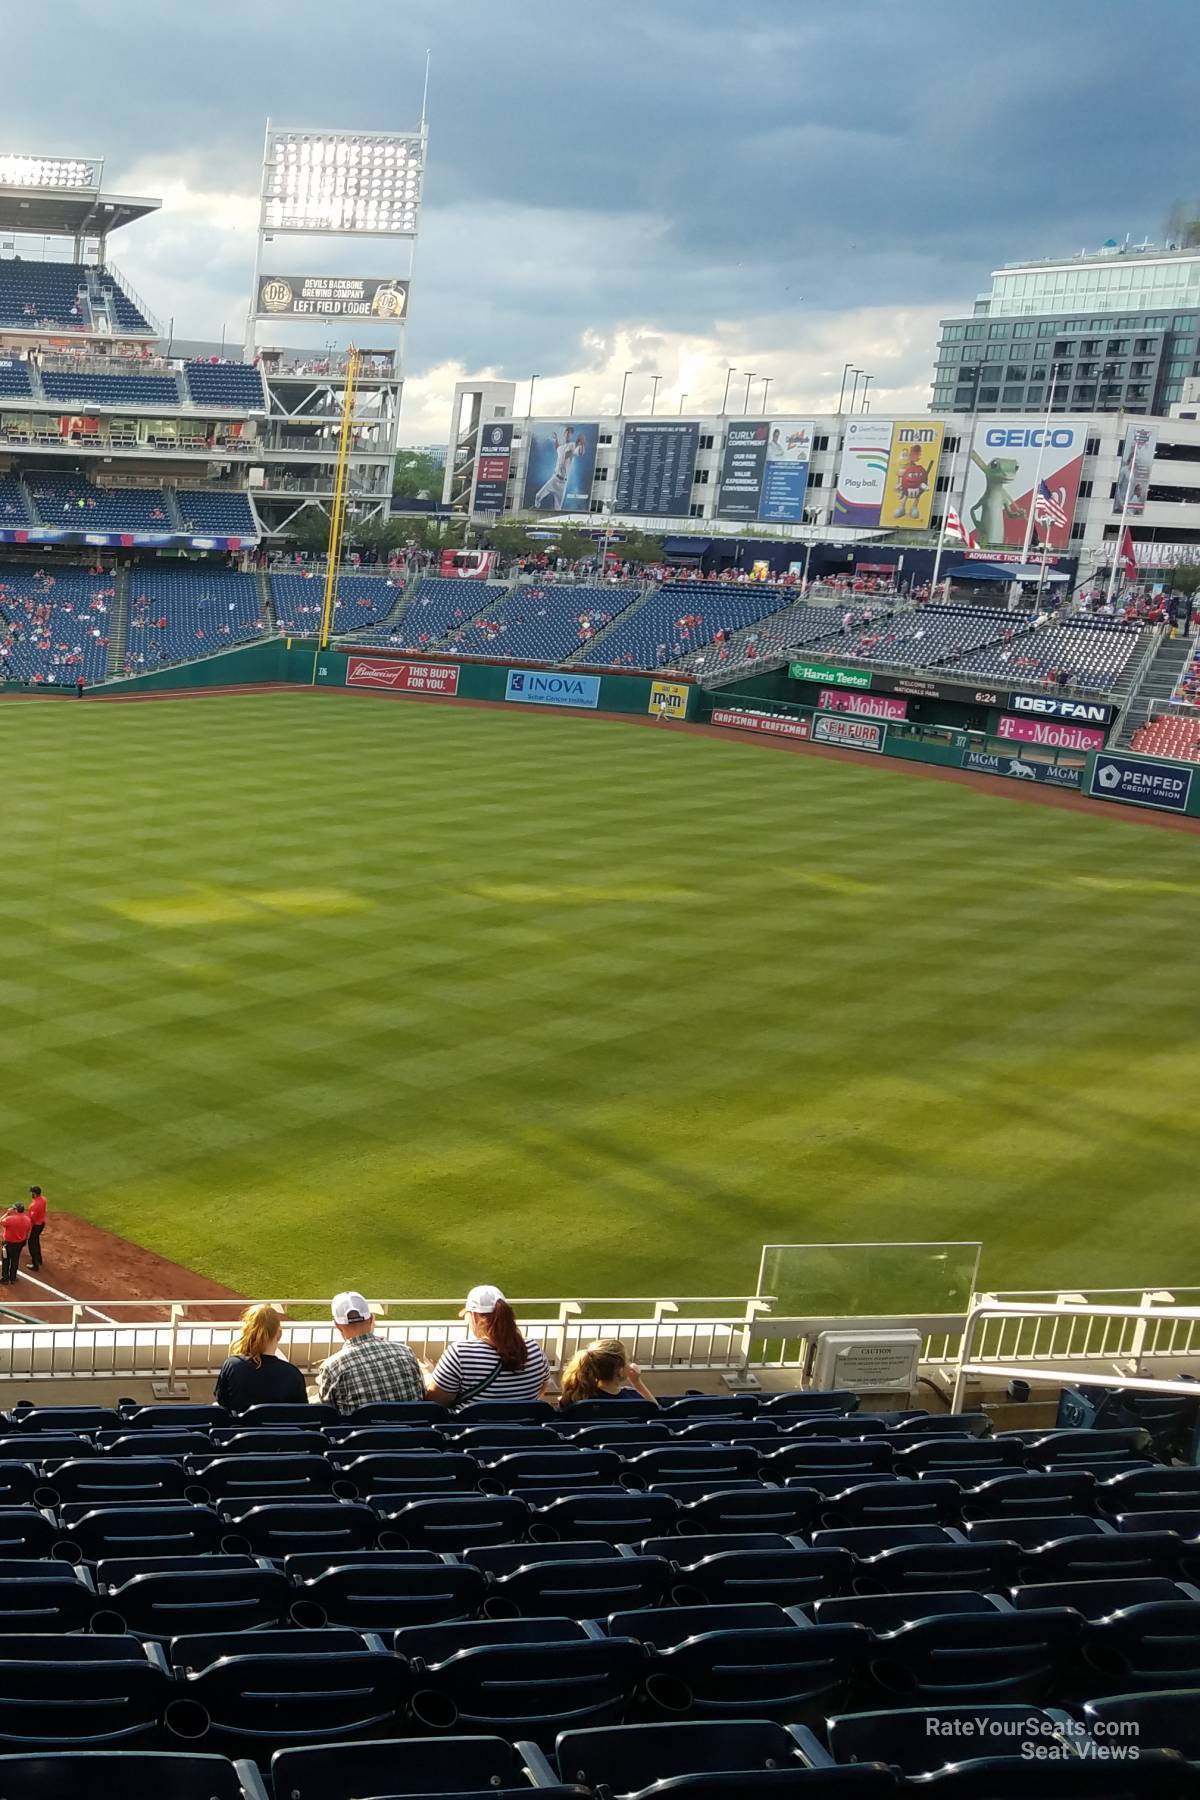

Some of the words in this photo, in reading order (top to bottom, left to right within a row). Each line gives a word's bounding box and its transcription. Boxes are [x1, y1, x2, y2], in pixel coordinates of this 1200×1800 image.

[304, 279, 328, 289] DEVILS
[329, 280, 364, 290] BACKBONE
[269, 286, 285, 301] DB
[302, 288, 332, 299] BREWING
[333, 289, 365, 299] COMPANY
[293, 300, 314, 313] LEFT
[316, 301, 341, 313] FIELD
[343, 302, 371, 314] LODGE
[729, 431, 756, 440] CURLY
[985, 428, 1074, 449] GEICO
[844, 478, 861, 488] Play
[862, 478, 878, 487] ball.
[969, 552, 1001, 561] ADVANCE
[355, 666, 397, 679] Budweiser
[408, 666, 429, 677] THIS
[430, 668, 457, 679] BUD'S
[803, 667, 835, 682] Harris
[836, 672, 869, 686] Teeter
[407, 678, 425, 688] FOR
[426, 679, 446, 690] YOU.
[528, 677, 584, 695] INOVA
[899, 680, 926, 689] WELCOME
[975, 692, 997, 704] 6:24
[1060, 702, 1105, 721] FAN
[714, 712, 759, 729] CRAFTSMAN
[760, 718, 808, 735] CRAFTSMAN
[955, 736, 967, 747] 377
[968, 752, 999, 767] MGM
[1046, 766, 1079, 781] MGM
[1123, 771, 1184, 791] PENFED
[1121, 783, 1151, 794] CREDIT
[1153, 788, 1181, 799] UNION
